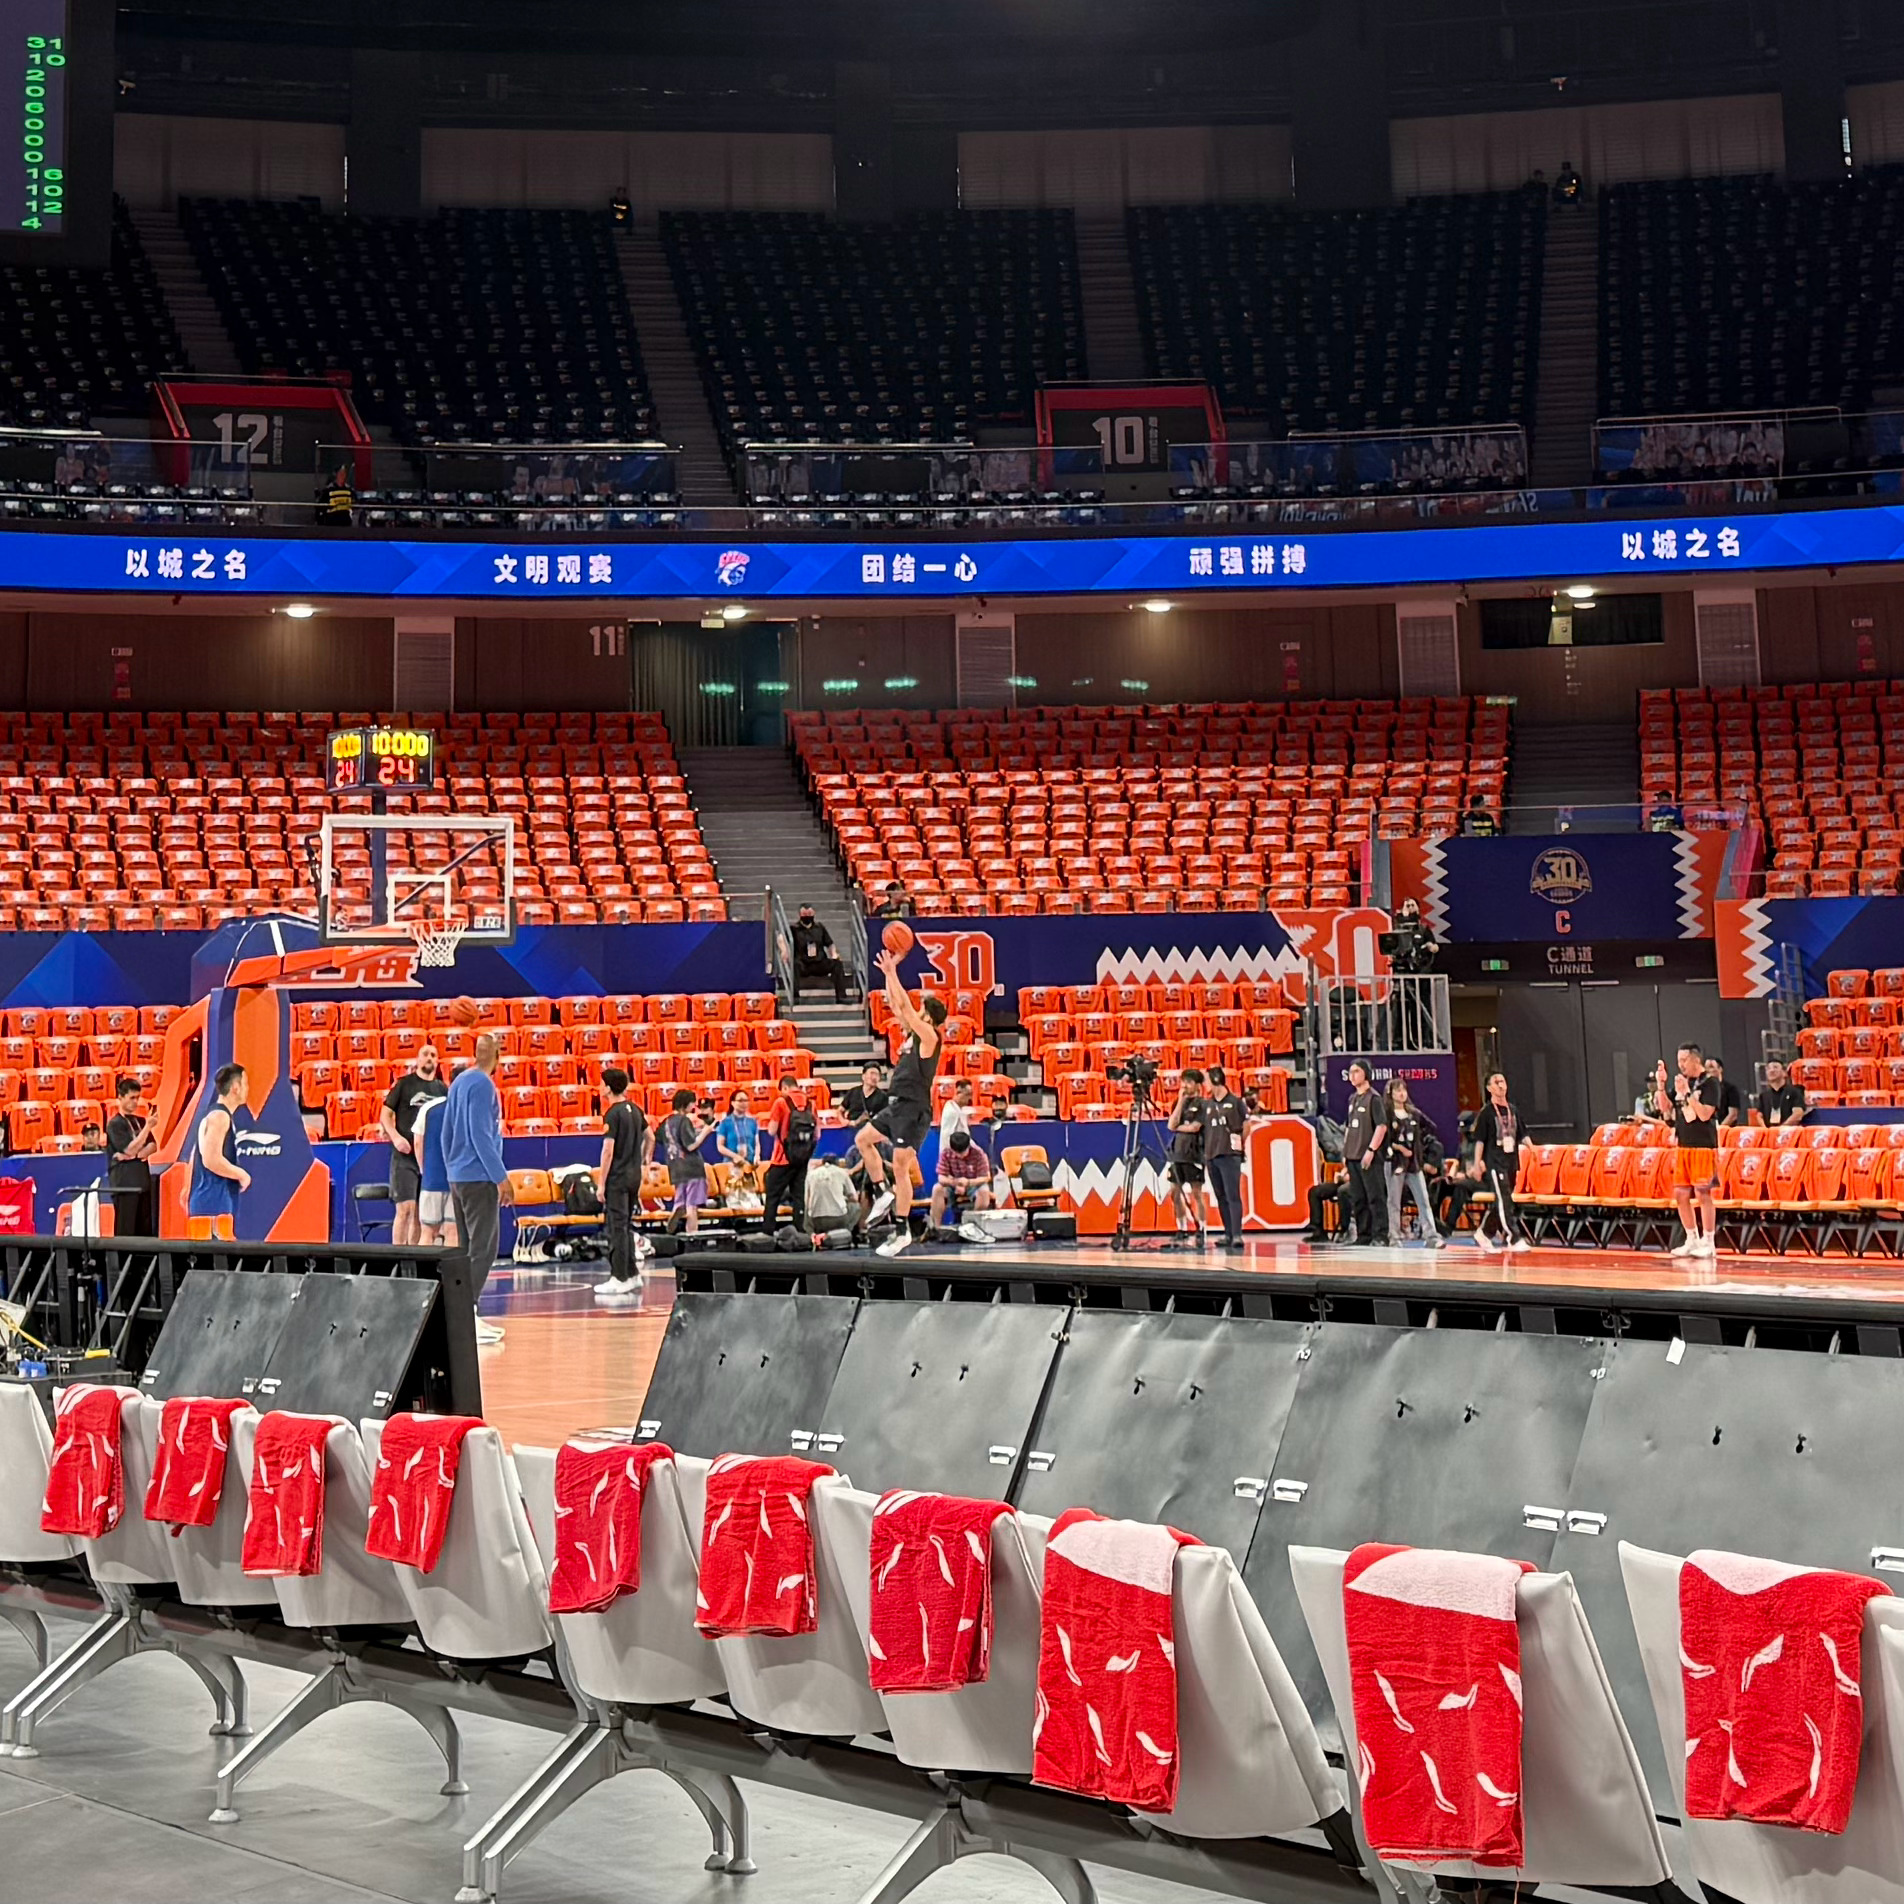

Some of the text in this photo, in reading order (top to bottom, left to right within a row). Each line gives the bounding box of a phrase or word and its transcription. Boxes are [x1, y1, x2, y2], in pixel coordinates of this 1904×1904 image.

[28, 37, 61, 49] 31
[29, 53, 65, 66] 10
[26, 69, 44, 81] 2
[26, 86, 44, 97] 0
[25, 102, 44, 113] 6
[25, 118, 44, 130] 0
[24, 135, 43, 146] 0
[24, 151, 43, 162] 0
[27, 168, 63, 180] 16
[27, 184, 62, 196] 10
[26, 200, 62, 213] 12
[22, 217, 41, 229] 4
[212, 412, 269, 466] 12
[1092, 416, 1145, 466] 10
[1621, 527, 1740, 561] 以城之名
[125, 548, 247, 580] 以城之名
[494, 553, 612, 585] 文明观赛
[862, 553, 977, 583] 团结一心
[1189, 544, 1307, 576] 顽强拼搏
[588, 626, 617, 657] 11
[335, 759, 355, 788] 24
[378, 756, 415, 787] 24
[1543, 856, 1577, 882] 30
[1555, 909, 1572, 934] C
[1270, 907, 1394, 1006] 30
[1548, 963, 1595, 975] TUNNEL
